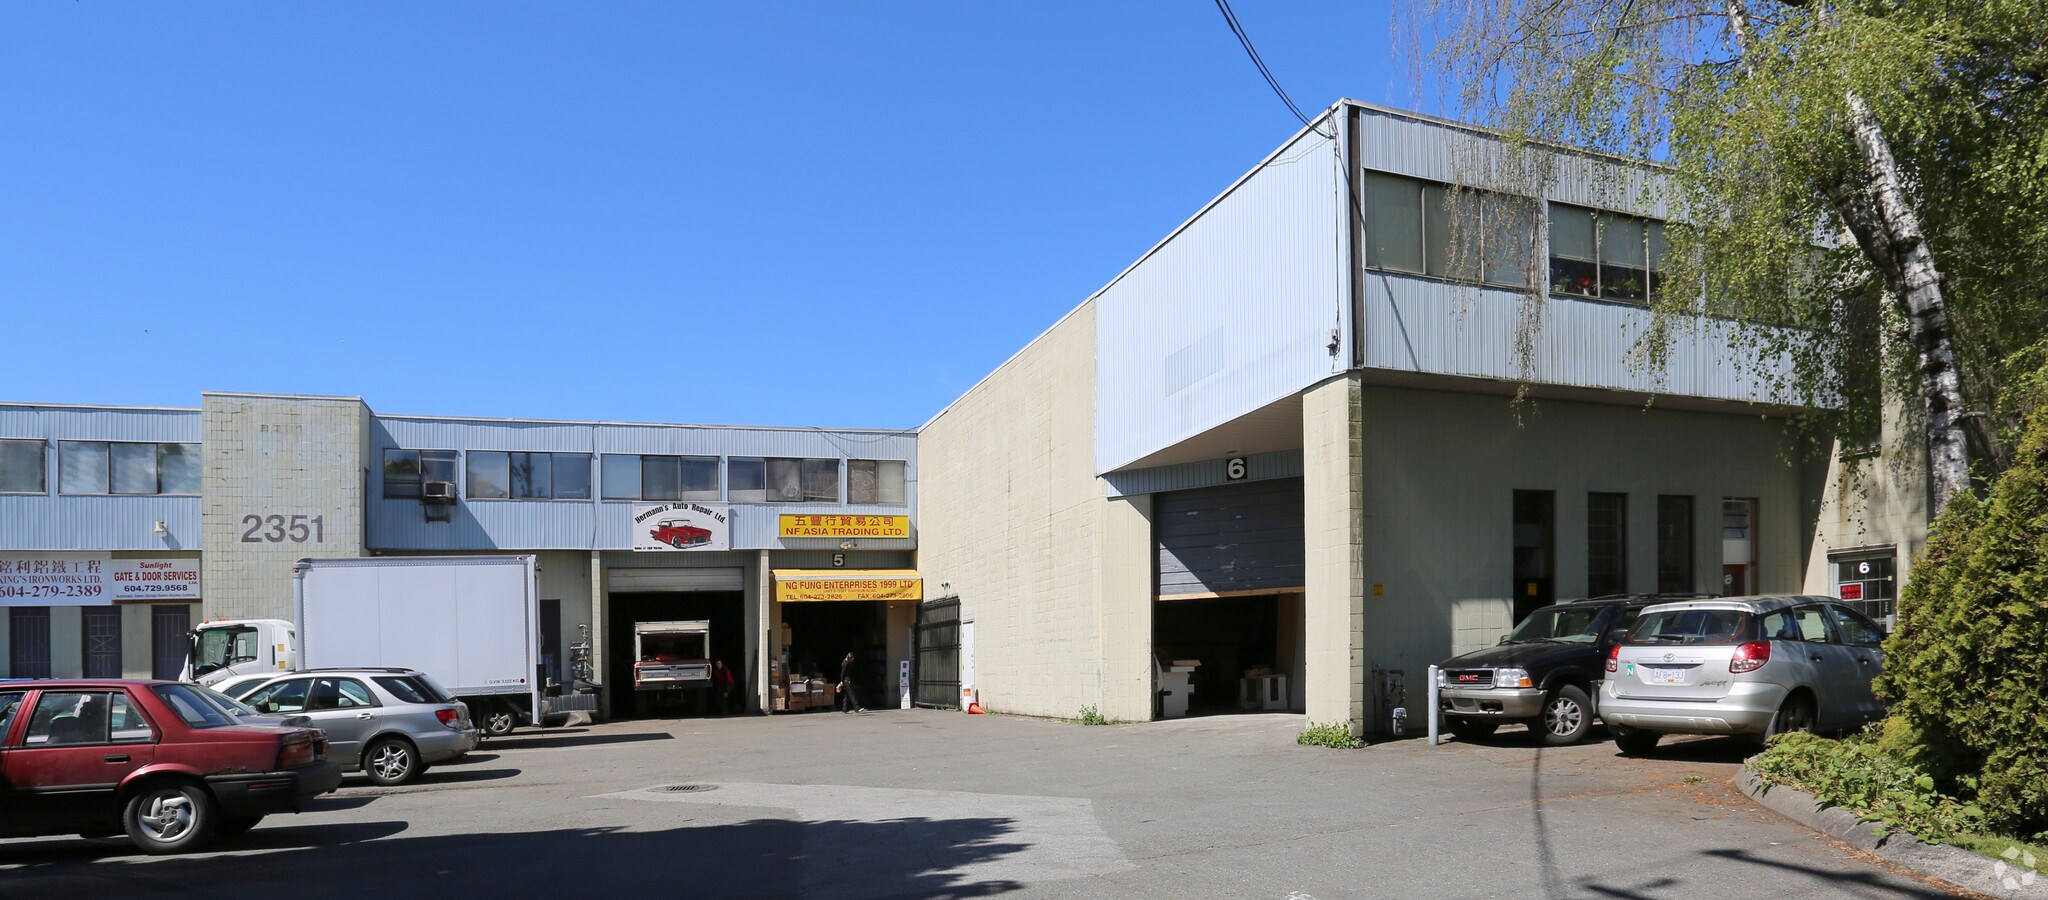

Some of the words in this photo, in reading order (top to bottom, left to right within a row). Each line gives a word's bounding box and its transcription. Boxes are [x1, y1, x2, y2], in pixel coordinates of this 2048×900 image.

[1227, 458, 1245, 479] 6
[634, 504, 669, 524] Hermann's
[672, 502, 689, 510] Auto
[691, 503, 713, 516] Repair
[714, 512, 726, 524] Ltd.
[795, 516, 894, 526] 五豐行貿易公司
[241, 514, 324, 543] 2351
[834, 554, 843, 566] 5
[140, 562, 172, 570] Sunlight
[1859, 562, 1870, 574] 6
[29, 575, 81, 584] IRONWORKS
[84, 575, 102, 584] LTD.
[114, 572, 133, 581] GATE
[135, 572, 140, 581] &
[142, 571, 162, 581] DOOR
[163, 571, 197, 580] SERVICES
[124, 584, 188, 592] 604.729.9568
[785, 582, 798, 590] NG
[800, 581, 821, 590] FUNG
[824, 581, 877, 589] ENTERPRISES
[880, 580, 897, 588] 1999
[0, 585, 102, 597] 604-279-2389
[1627, 668, 1634, 676] N
